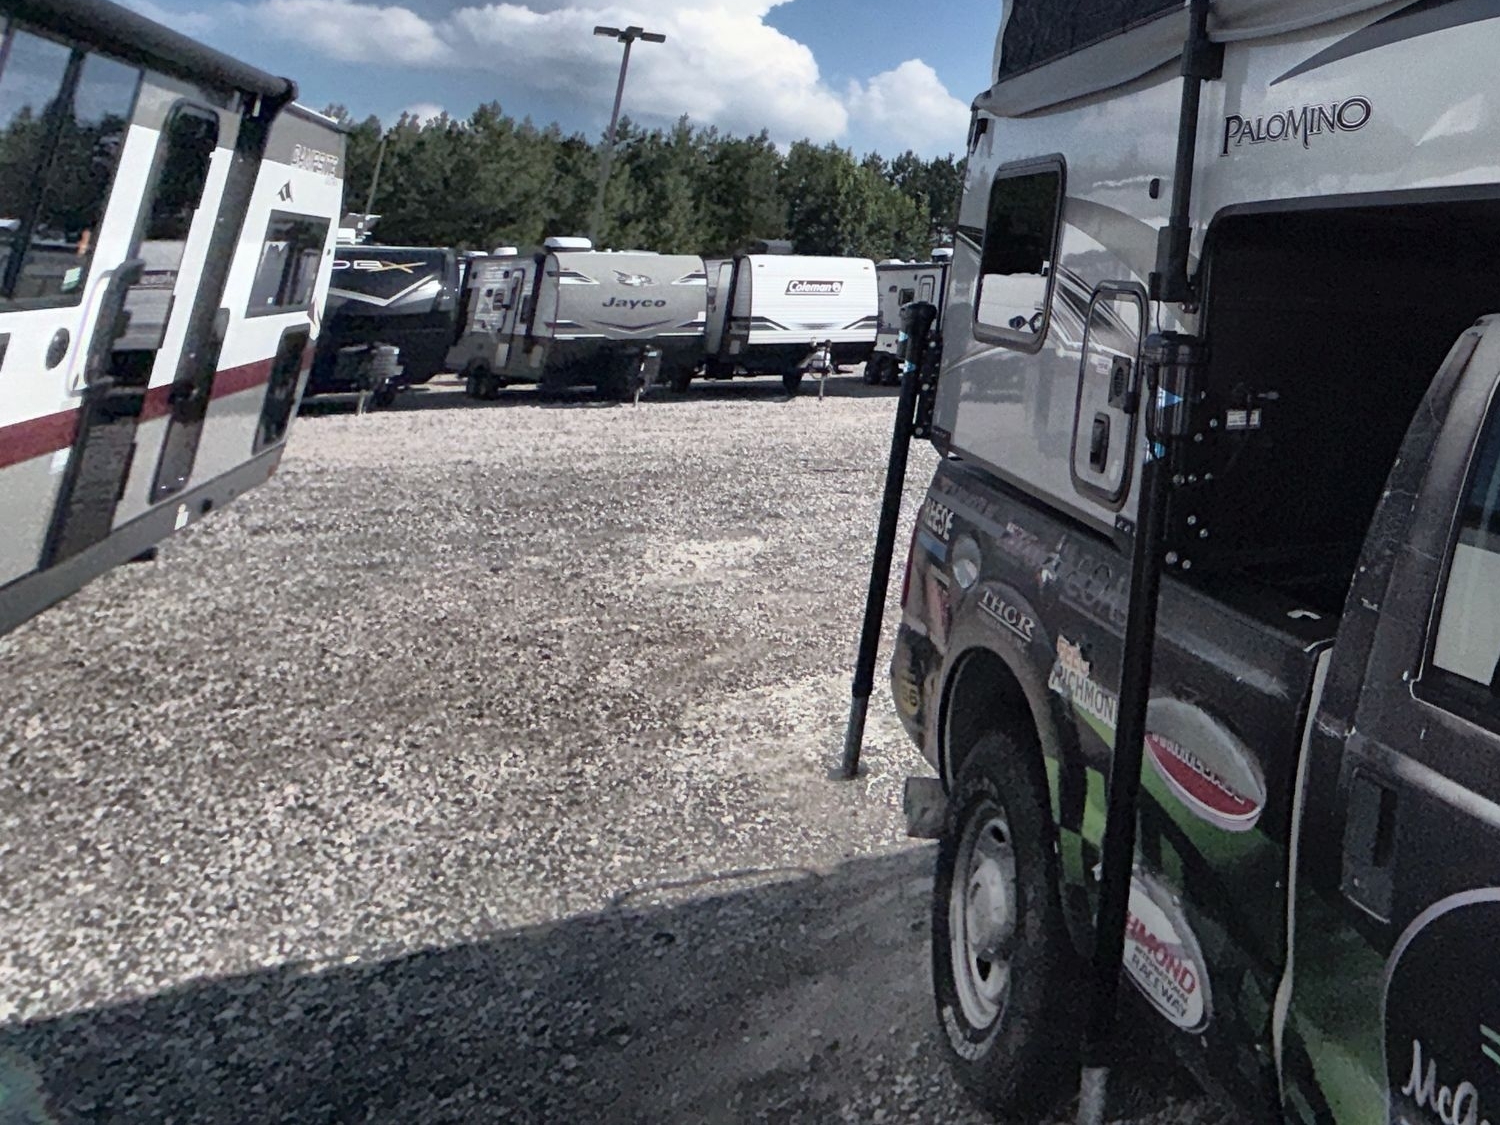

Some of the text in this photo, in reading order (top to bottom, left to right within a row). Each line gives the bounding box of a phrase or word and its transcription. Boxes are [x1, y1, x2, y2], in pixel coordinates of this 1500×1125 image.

[1221, 95, 1373, 156] PALOMINO
[601, 296, 667, 310] Jayco
[788, 280, 833, 292] Coleman
[979, 588, 1037, 639] THOR
[1049, 668, 1119, 730] RICHMON
[1125, 911, 1196, 995] HMOND
